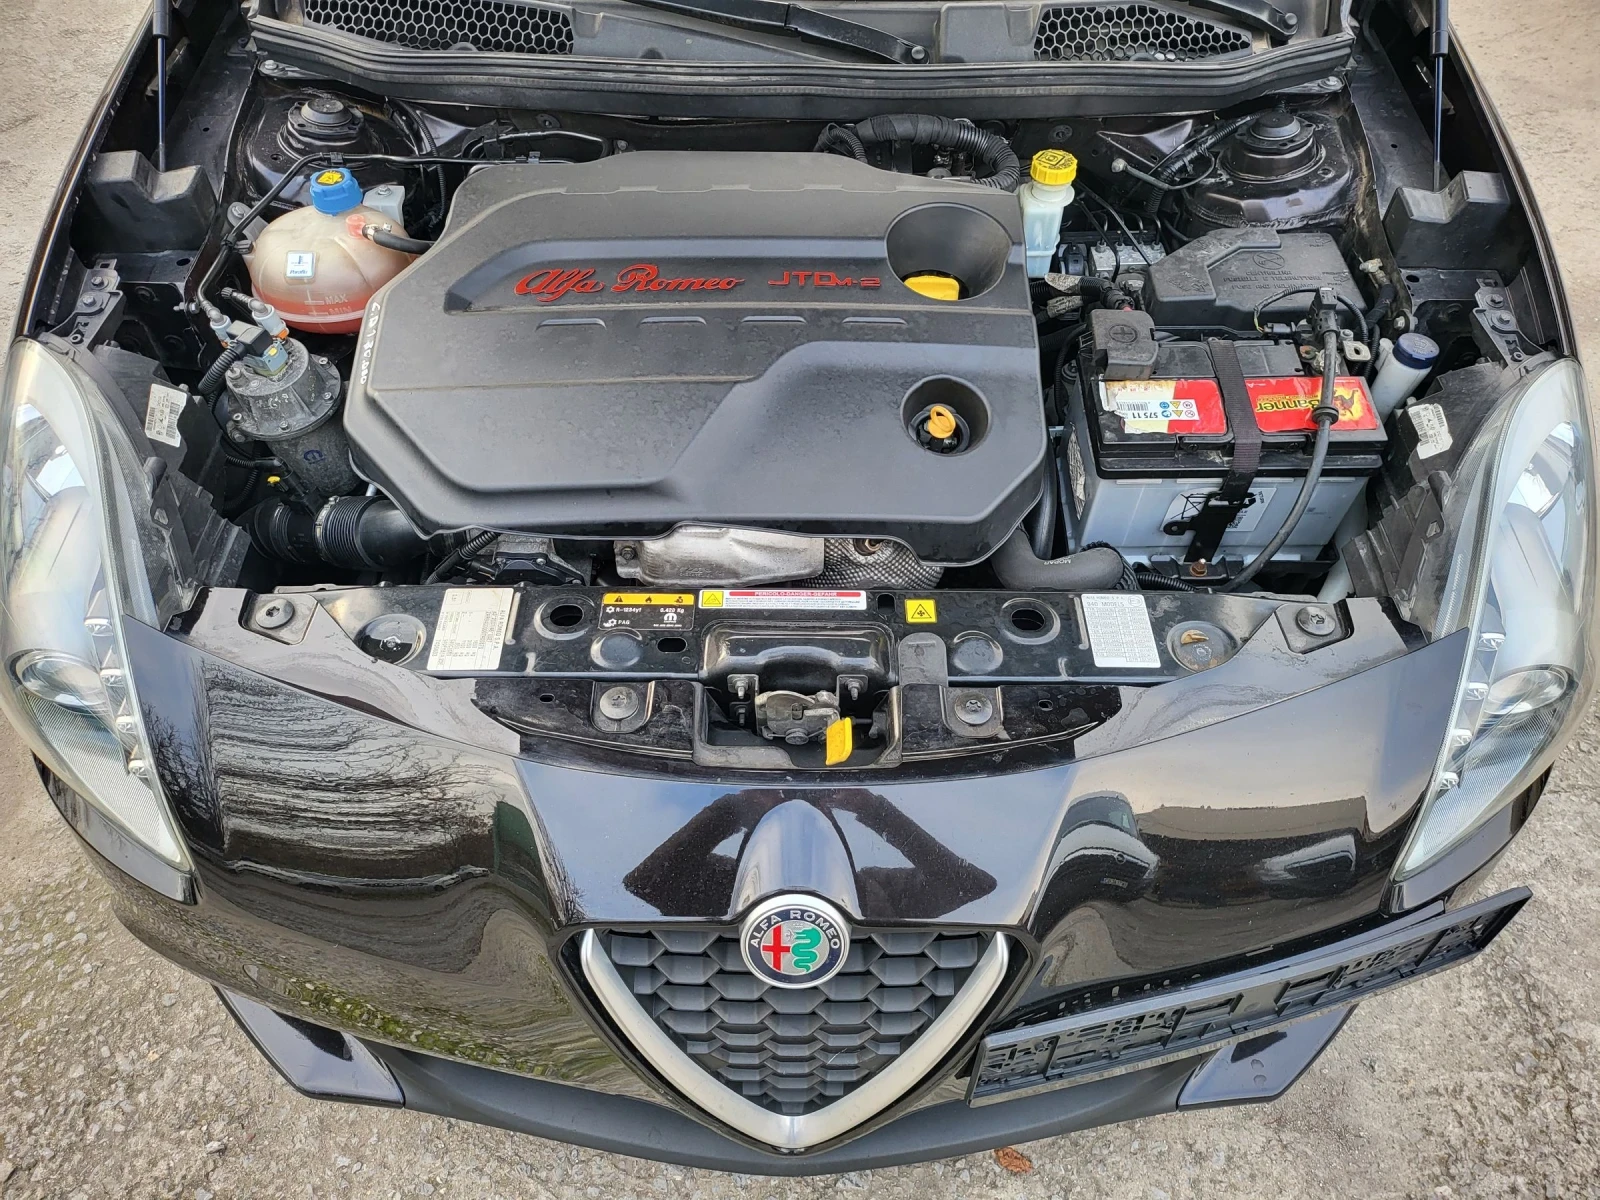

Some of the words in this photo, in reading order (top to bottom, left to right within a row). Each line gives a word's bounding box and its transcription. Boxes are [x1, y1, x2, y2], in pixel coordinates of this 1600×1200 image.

[514, 268, 604, 302] Alfa
[610, 264, 746, 292] Romeo
[325, 294, 348, 305] MAX
[329, 306, 352, 315] MIN
[1256, 400, 1320, 411] Banner
[750, 914, 782, 948] ALFA
[790, 910, 840, 949] ROMEO
